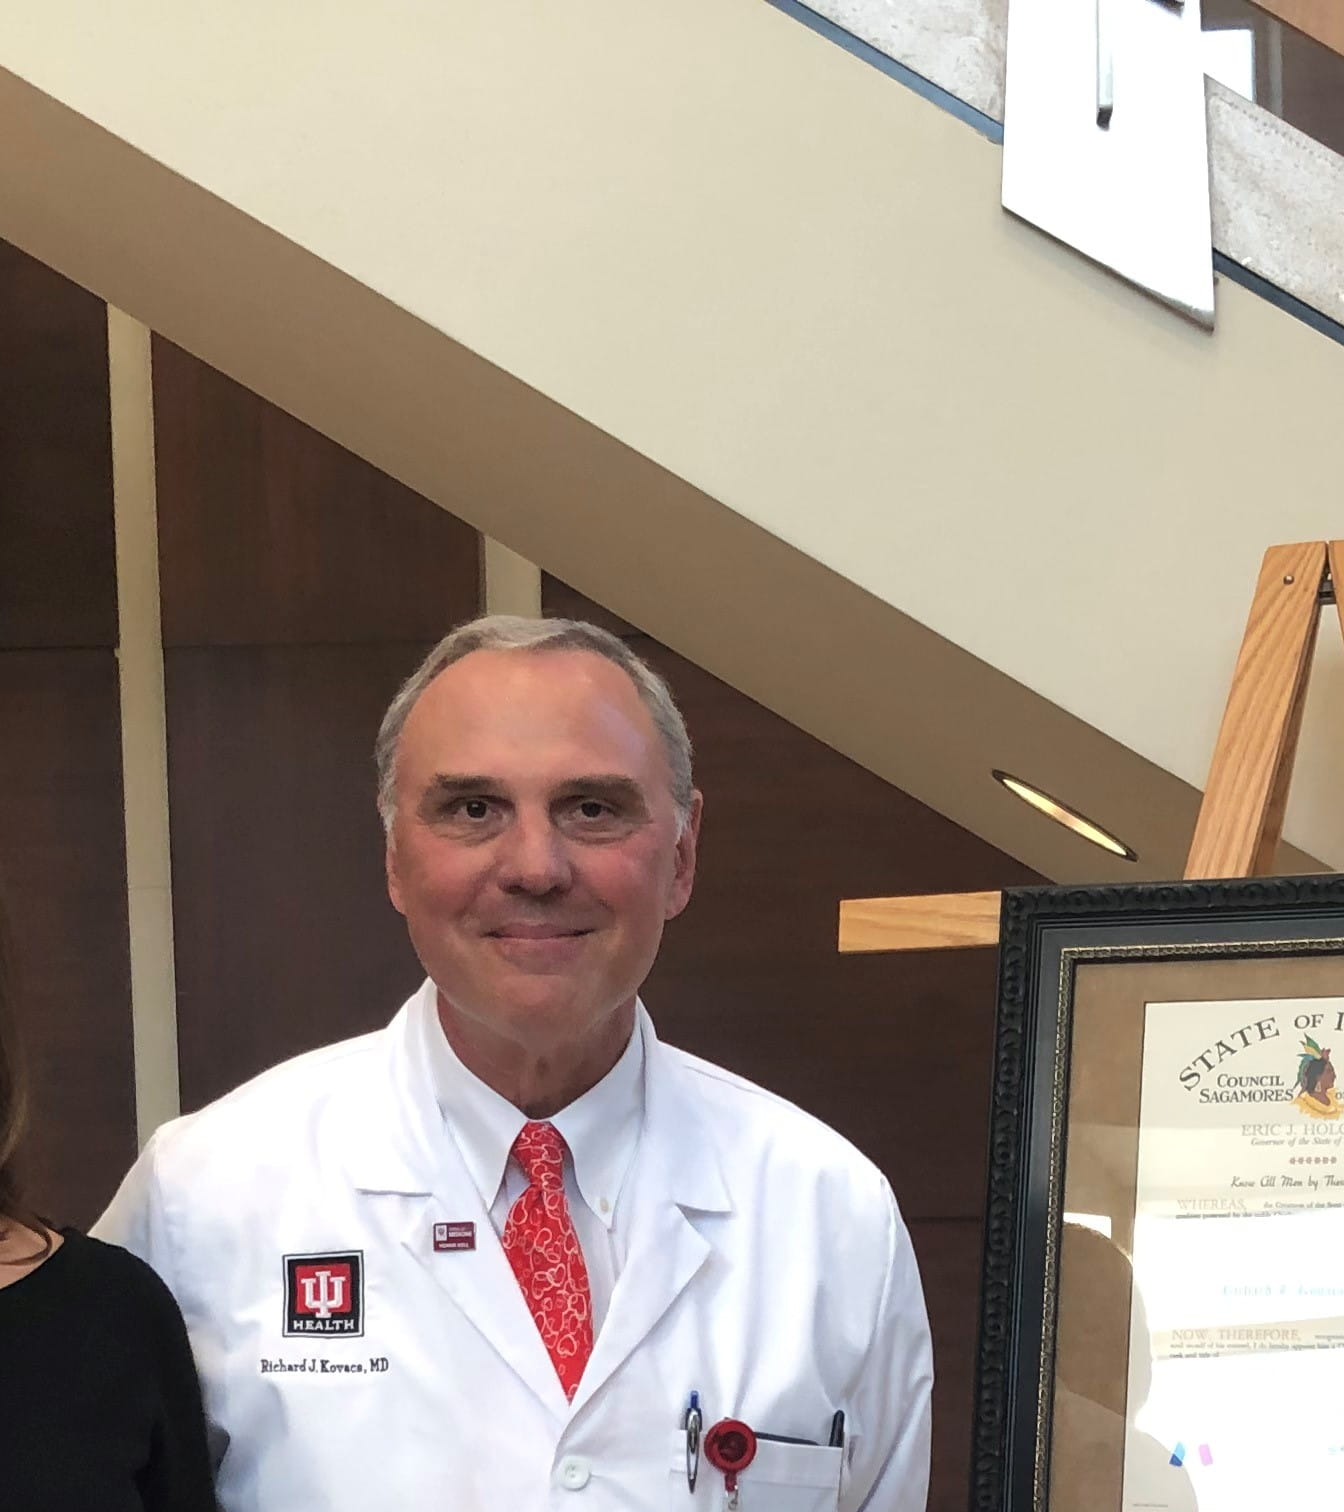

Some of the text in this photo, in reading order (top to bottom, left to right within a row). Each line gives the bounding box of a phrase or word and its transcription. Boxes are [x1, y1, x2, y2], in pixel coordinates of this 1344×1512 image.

[1179, 1017, 1280, 1091] STATE
[1294, 1014, 1324, 1029] OF
[1217, 1073, 1285, 1088] COUNCIL
[1199, 1088, 1294, 1103] SAGAMORES
[1241, 1123, 1281, 1137] ERIC
[1286, 1123, 1297, 1136] J.
[293, 1319, 354, 1331] HEALTH
[261, 1357, 390, 1374] Richard J. Kovacs, MD
